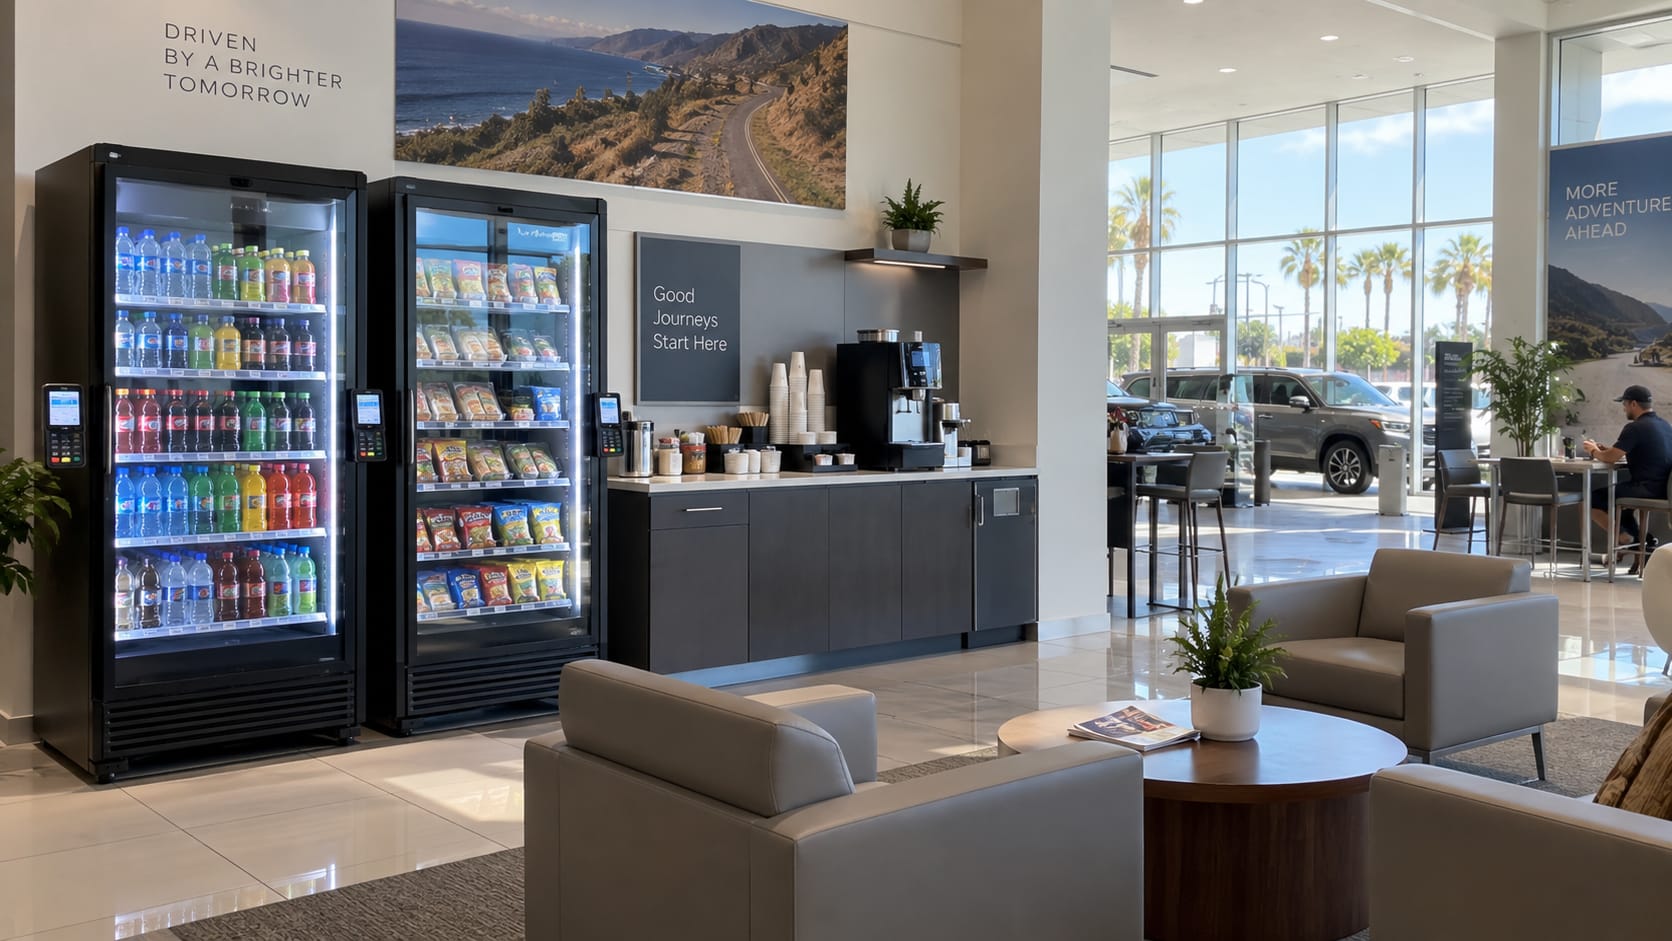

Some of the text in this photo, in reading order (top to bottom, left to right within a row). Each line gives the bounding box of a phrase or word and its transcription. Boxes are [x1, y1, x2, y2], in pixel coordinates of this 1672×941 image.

[165, 23, 256, 52] DRIVEN
[165, 48, 342, 89] BY A BRIGHTER
[163, 73, 311, 108] TOMORROW
[1566, 181, 1618, 200] MORE
[1565, 196, 1672, 220] ADVENTURE
[1565, 222, 1627, 240] AHEAD
[653, 285, 695, 303] Good
[653, 309, 718, 330] Journeys
[653, 333, 727, 351] Start Here
